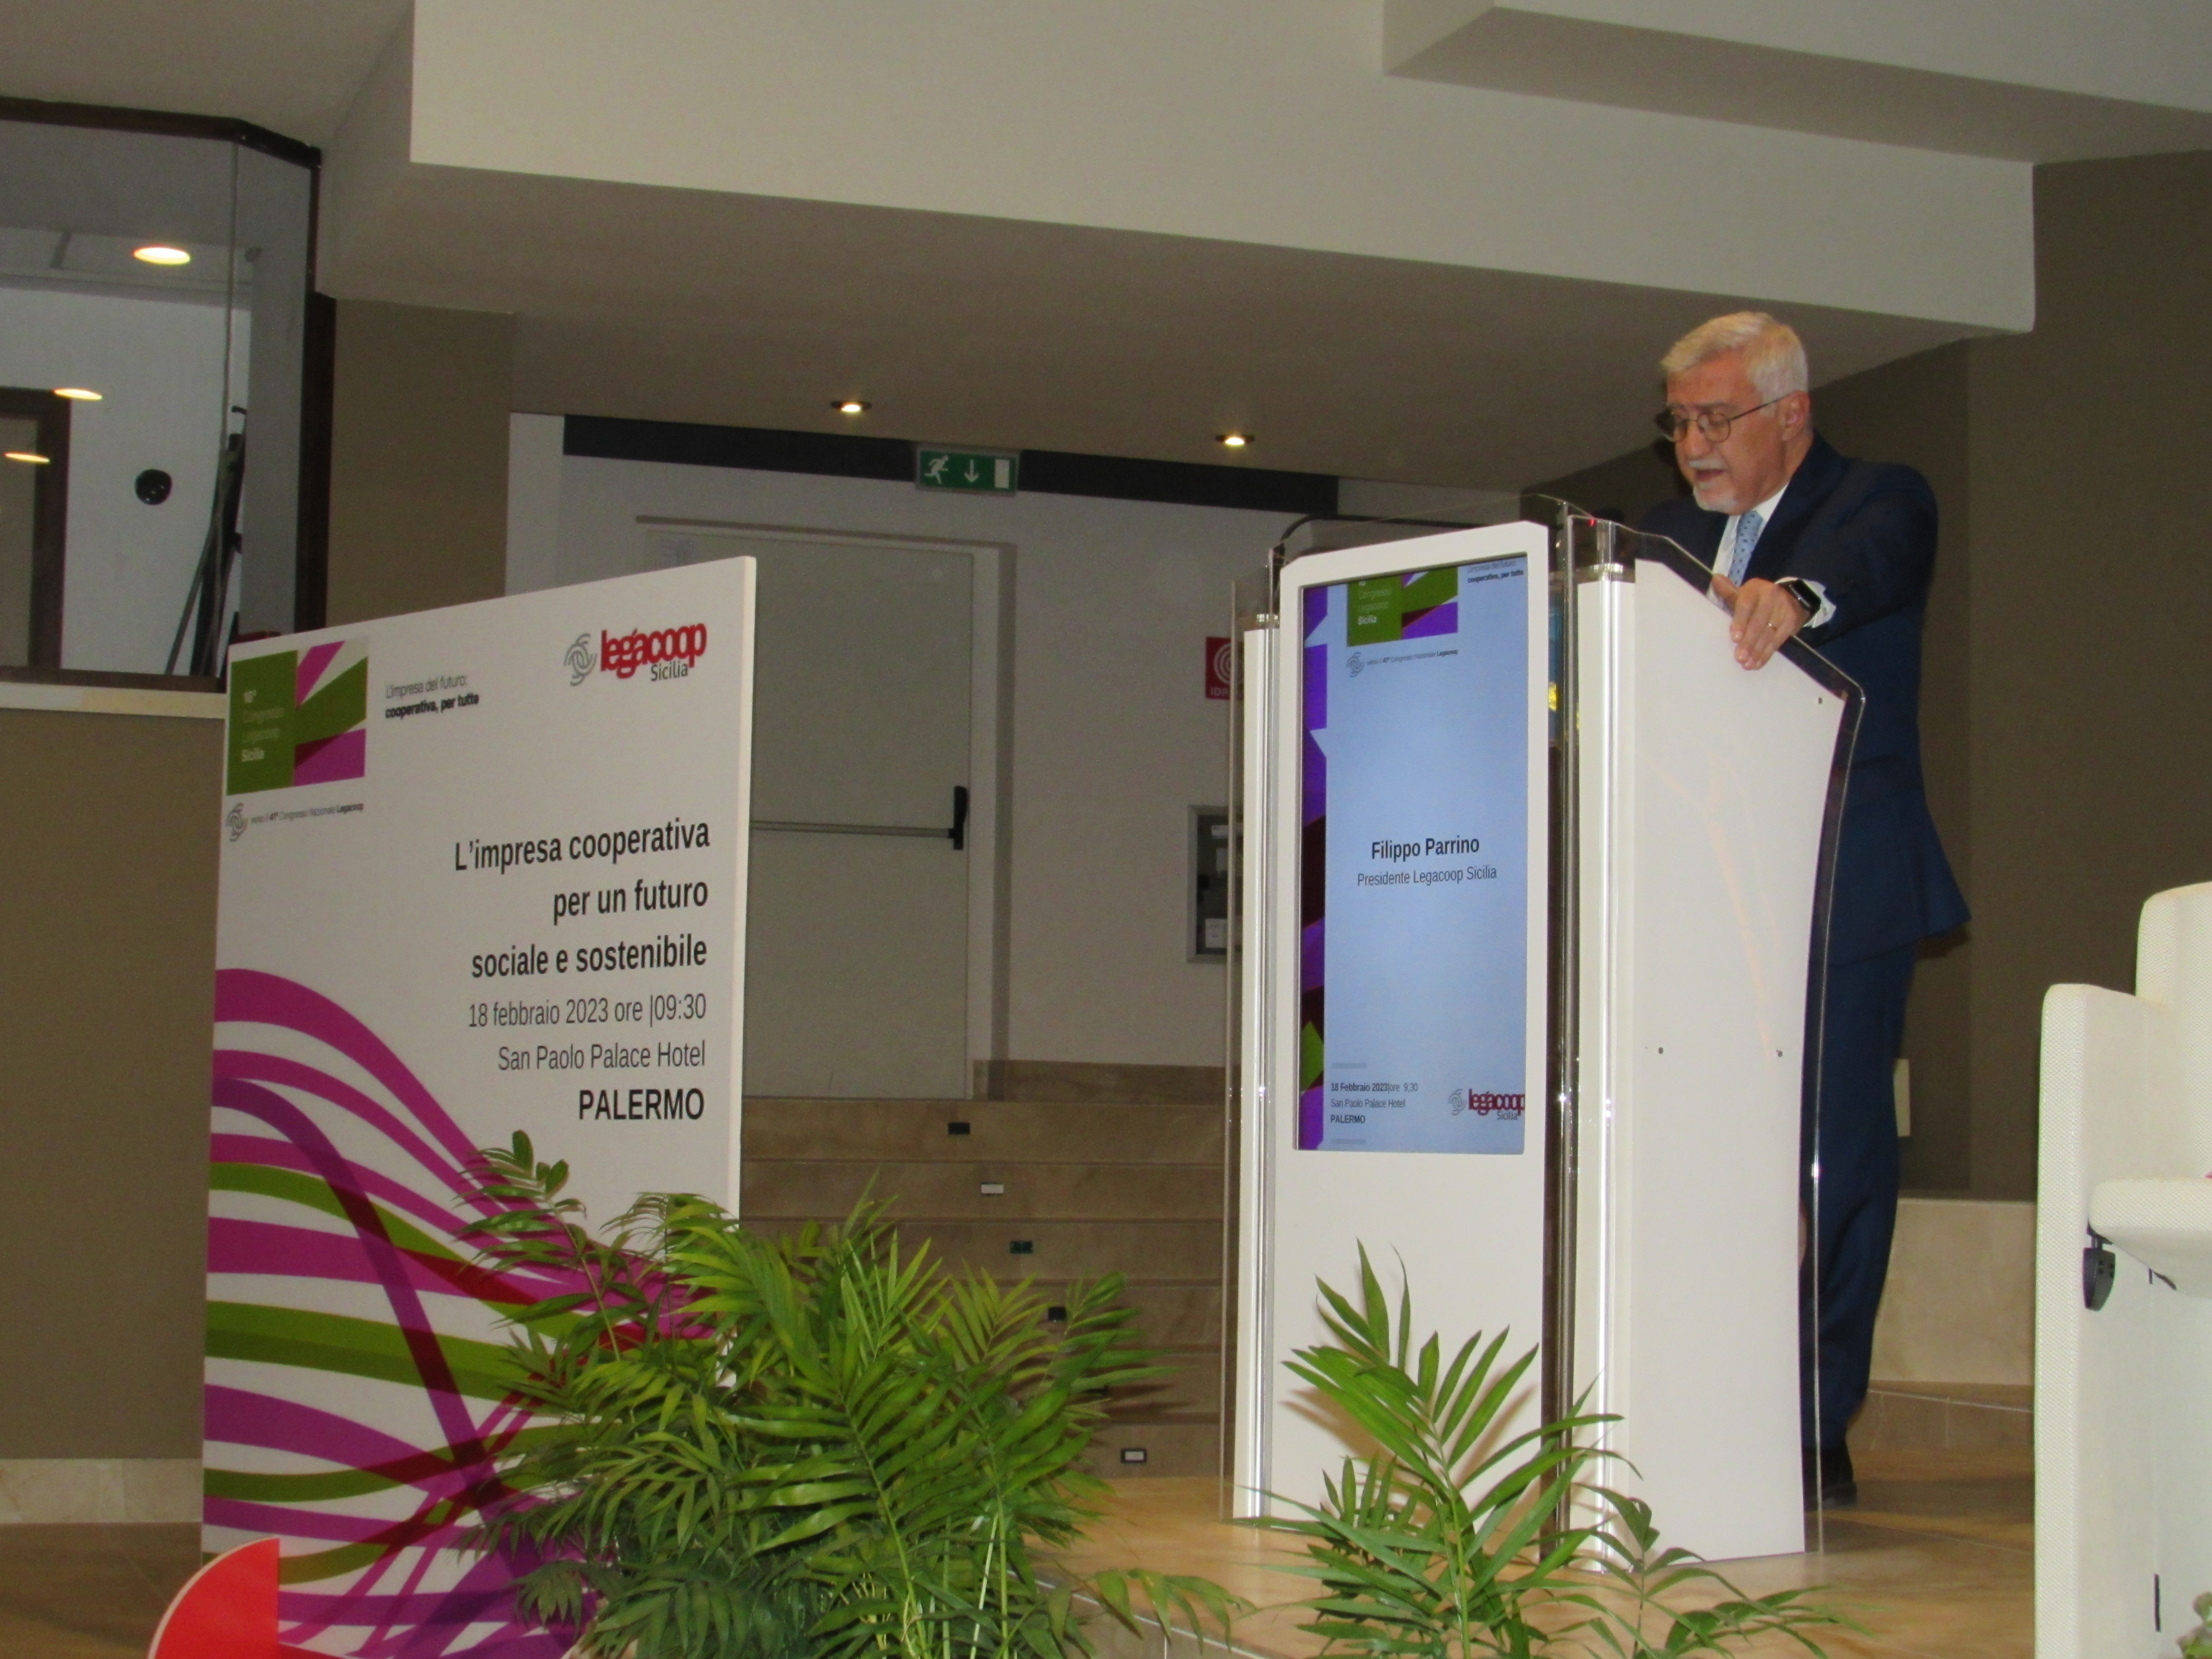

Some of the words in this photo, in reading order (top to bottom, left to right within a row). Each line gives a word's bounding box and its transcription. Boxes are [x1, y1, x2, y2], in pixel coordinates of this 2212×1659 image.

[650, 661, 688, 682] Sicilia
[425, 677, 439, 692] del
[441, 698, 456, 713] per
[569, 817, 711, 864] cooperativa
[1371, 841, 1421, 863] Filippo
[1425, 835, 1480, 856] Parrino
[1358, 872, 1410, 886] Presidente
[1413, 869, 1463, 886] Legacoop
[1467, 864, 1497, 880] Sicilia
[554, 891, 591, 926] per
[598, 886, 627, 914] un
[634, 878, 708, 911] futuro
[472, 943, 549, 978] sociale
[556, 948, 568, 973] e
[576, 933, 707, 972] sostenibile
[469, 1003, 488, 1027] 18
[493, 999, 560, 1027] febbraio
[566, 997, 608, 1024] 2023
[614, 1001, 642, 1022] ore
[498, 1046, 530, 1071] San
[537, 1043, 585, 1070] Paolo
[591, 1042, 651, 1068] Palace
[658, 1040, 706, 1067] Hotel
[1331, 1083, 1339, 1092] 18
[1340, 1083, 1370, 1092] Febbraio
[579, 1088, 705, 1120] PALERMO
[1331, 1099, 1343, 1107] San
[1345, 1098, 1363, 1107] Paolo
[1365, 1098, 1386, 1108] Palace
[1388, 1099, 1405, 1108] Hotel
[1331, 1114, 1366, 1123] PALERMO
[1496, 1110, 1517, 1120] Sicilia
